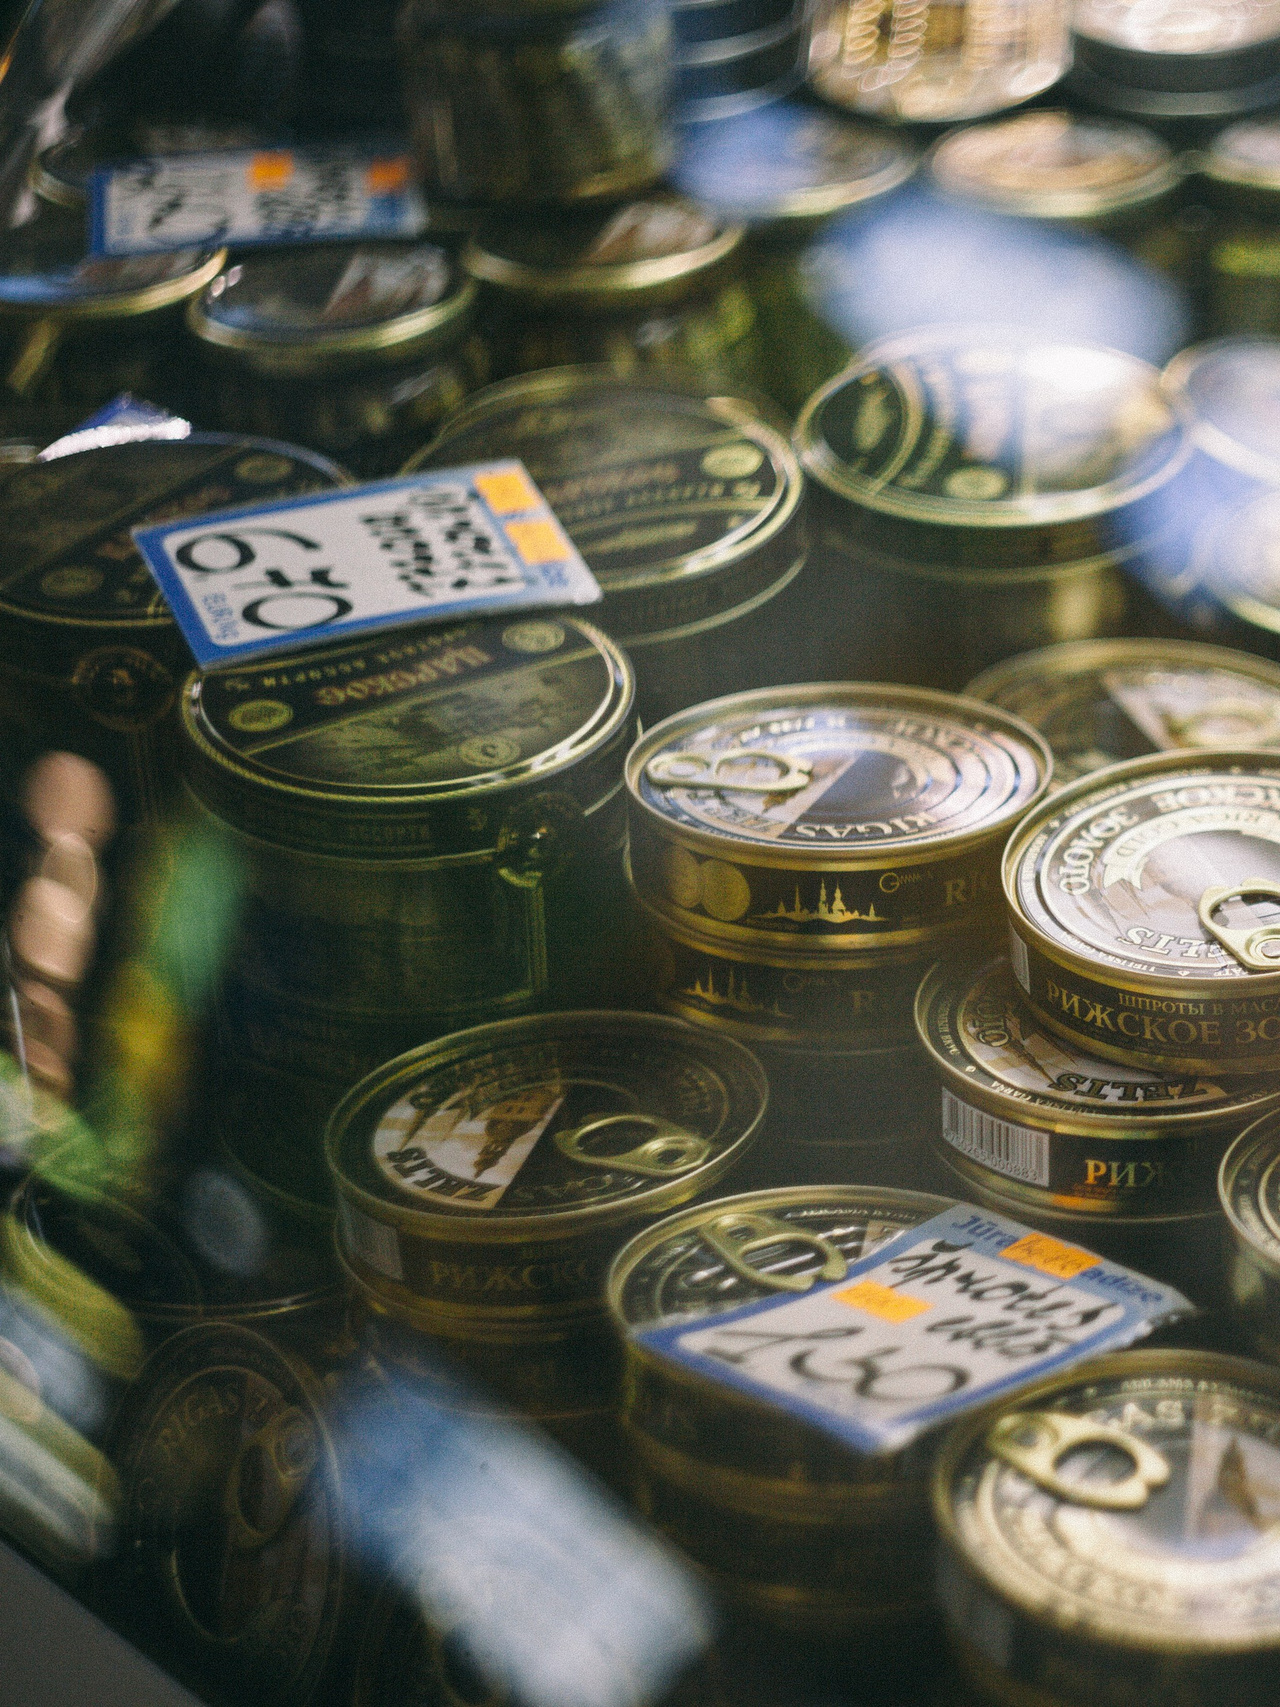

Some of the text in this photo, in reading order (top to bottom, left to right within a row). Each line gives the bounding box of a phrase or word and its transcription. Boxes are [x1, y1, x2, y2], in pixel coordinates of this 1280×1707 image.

[1058, 804, 1139, 896] ЗОЛОТО
[1046, 978, 1223, 1046] РИЖСКОЕ
[1117, 991, 1205, 1016] ШПРОТЫ
[1047, 1072, 1210, 1103] ZELTS
[952, 1214, 1015, 1249] Jūra
